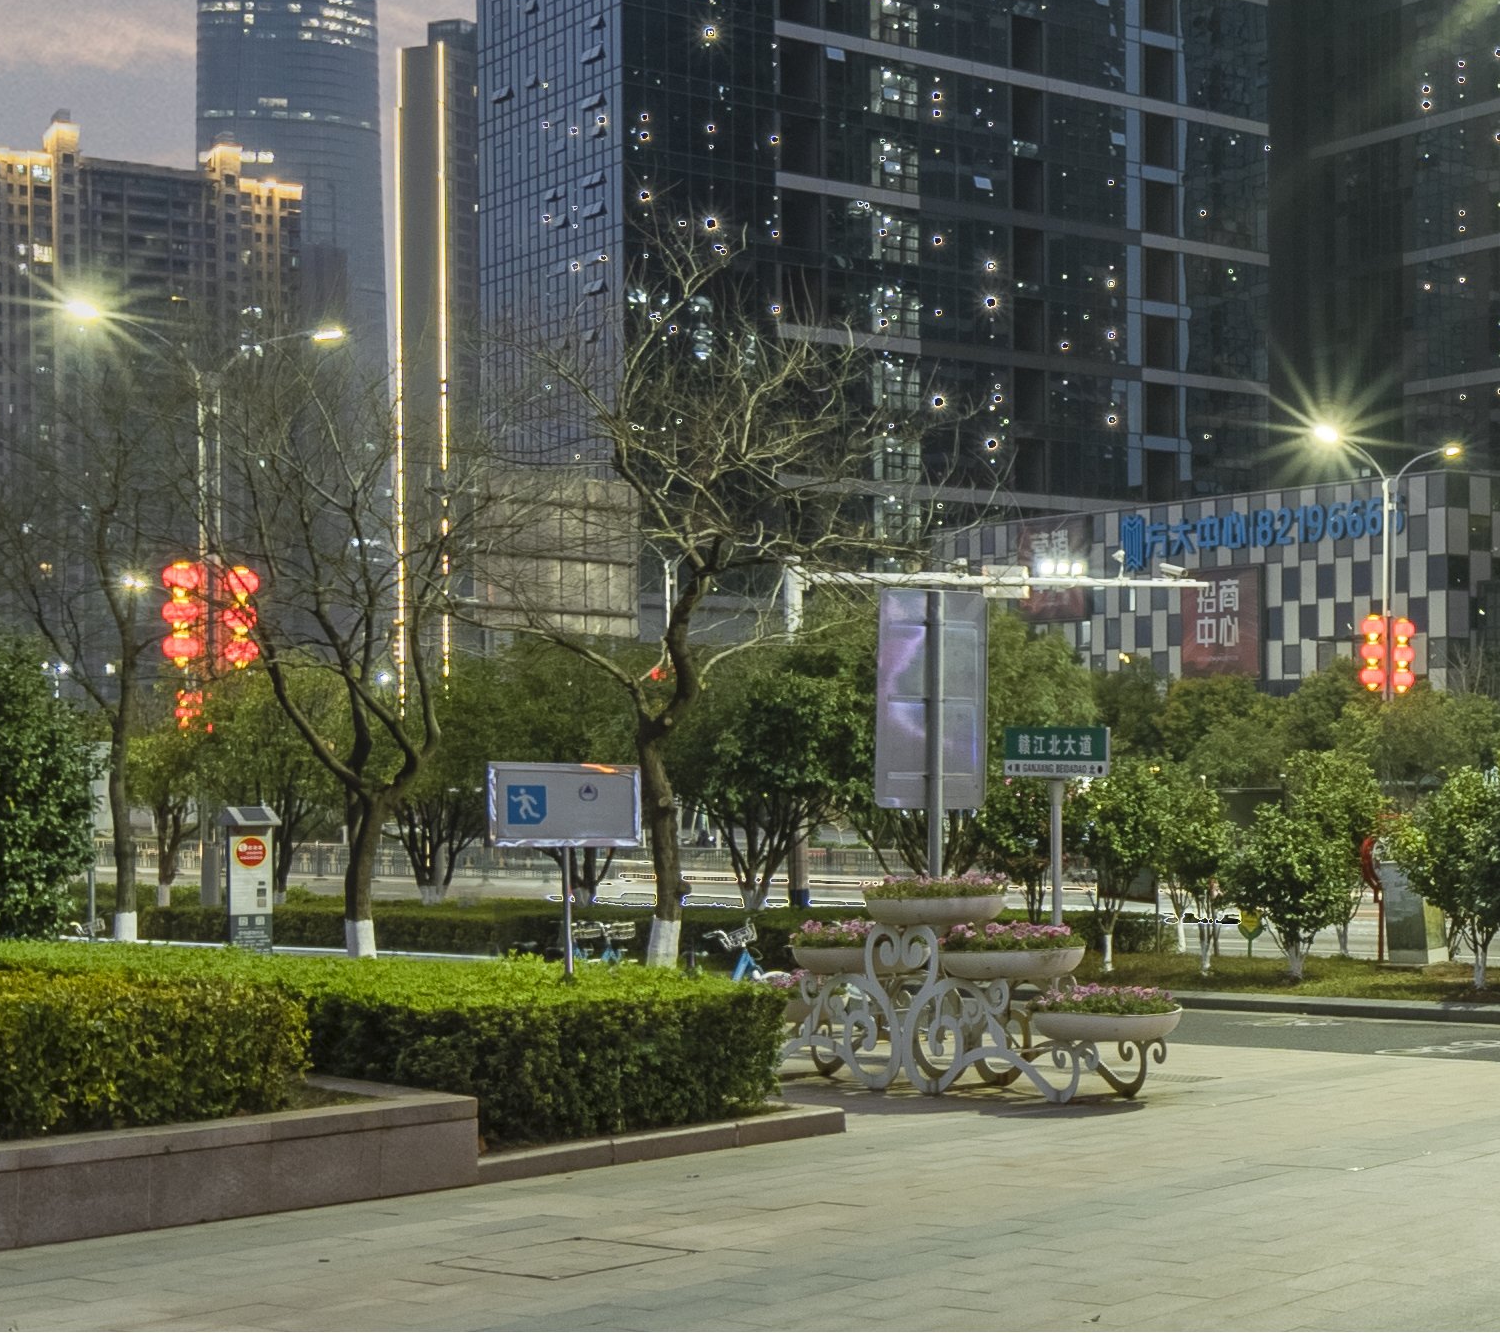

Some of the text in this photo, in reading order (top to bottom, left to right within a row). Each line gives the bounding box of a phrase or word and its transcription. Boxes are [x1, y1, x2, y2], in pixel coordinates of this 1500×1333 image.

[1145, 510, 1248, 559] 方大中心
[1196, 579, 1240, 614] 招商
[1196, 615, 1240, 648] 中心
[1018, 734, 1093, 756] 赣江北大道
